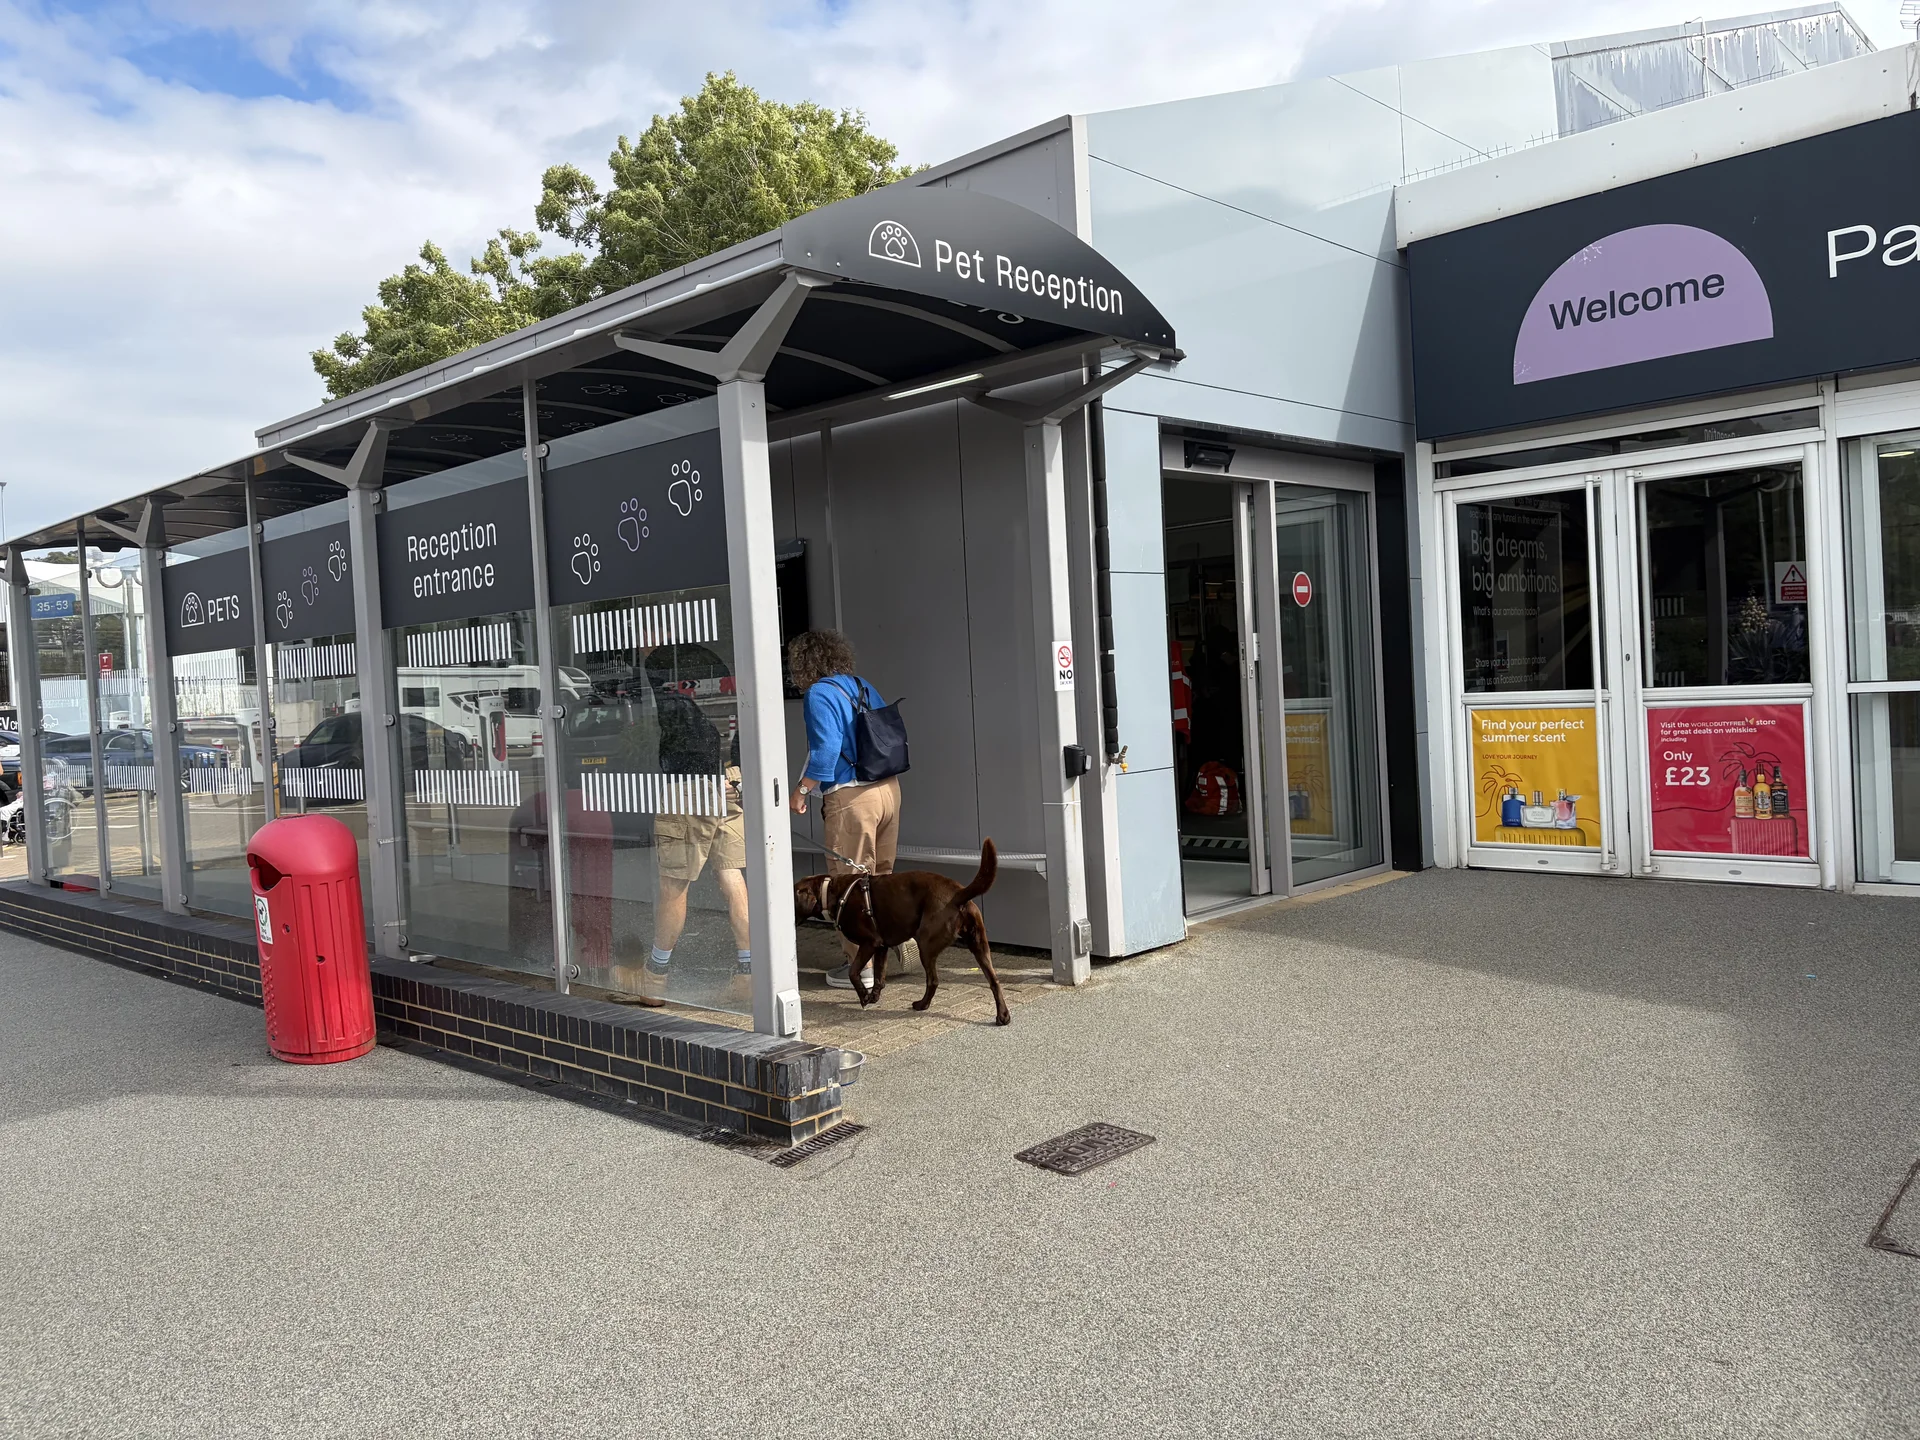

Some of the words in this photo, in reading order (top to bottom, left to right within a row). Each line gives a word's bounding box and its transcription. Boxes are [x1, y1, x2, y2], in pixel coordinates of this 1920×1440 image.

[935, 239, 986, 284] Pet
[996, 254, 1124, 316] Reception
[1548, 272, 1726, 331] Welcome
[406, 521, 498, 563] Reception
[1470, 529, 1493, 563] Big
[1495, 532, 1548, 562] dreams,
[413, 563, 495, 599] entrance
[1472, 564, 1494, 599] big
[1497, 567, 1559, 595] ambitions.
[37, 600, 69, 612] 35-53
[207, 595, 240, 624] PETS
[1059, 669, 1073, 680] NO
[1481, 719, 1507, 730] Find
[1510, 720, 1537, 732] your
[1540, 719, 1585, 732] perfect
[1693, 727, 1712, 735] deals
[1725, 726, 1757, 734] whiskies
[1756, 718, 1776, 726] store
[1482, 733, 1530, 743] summer
[1532, 732, 1566, 743] scent
[1663, 750, 1693, 763] Only
[1665, 766, 1711, 786] £23
